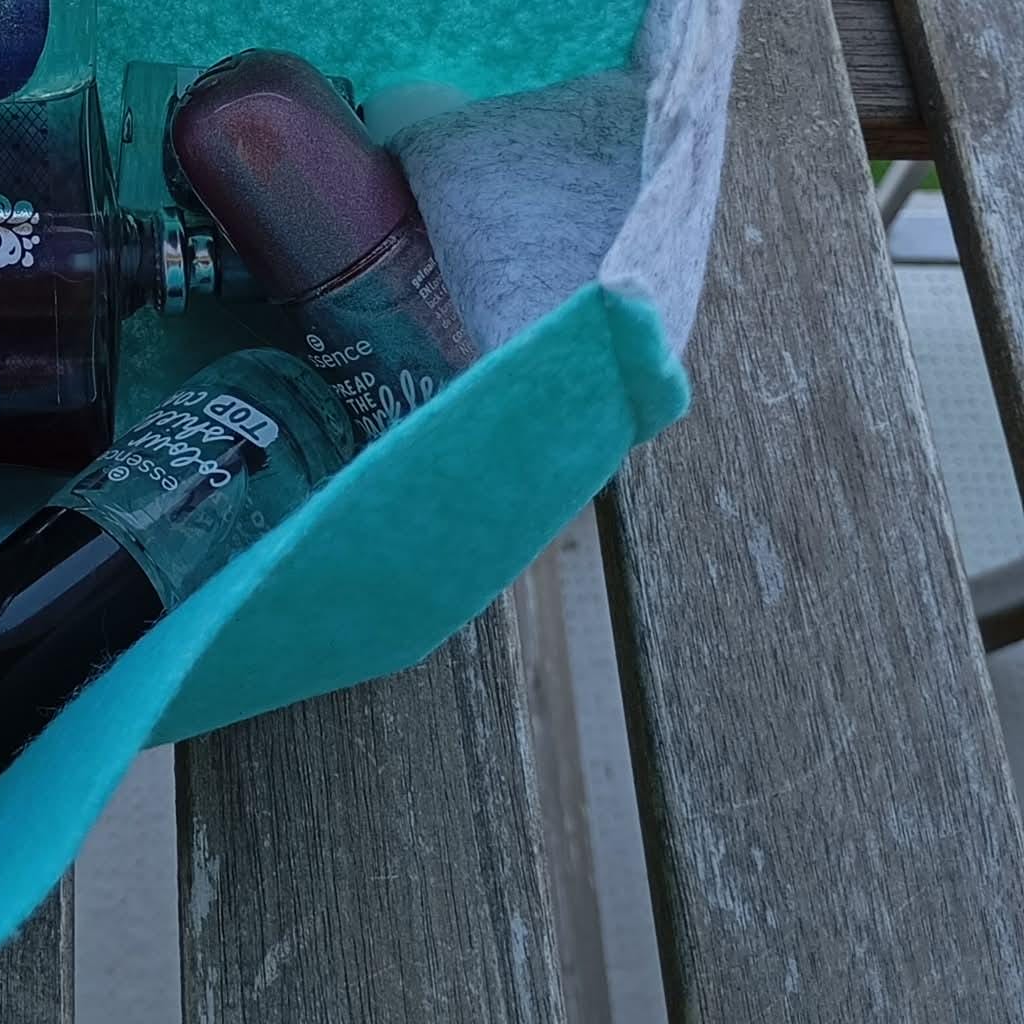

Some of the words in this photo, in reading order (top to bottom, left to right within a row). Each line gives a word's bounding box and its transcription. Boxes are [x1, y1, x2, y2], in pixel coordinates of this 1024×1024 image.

[212, 401, 268, 440] TOP
[346, 393, 376, 415] THE
[97, 449, 179, 491] essenc
